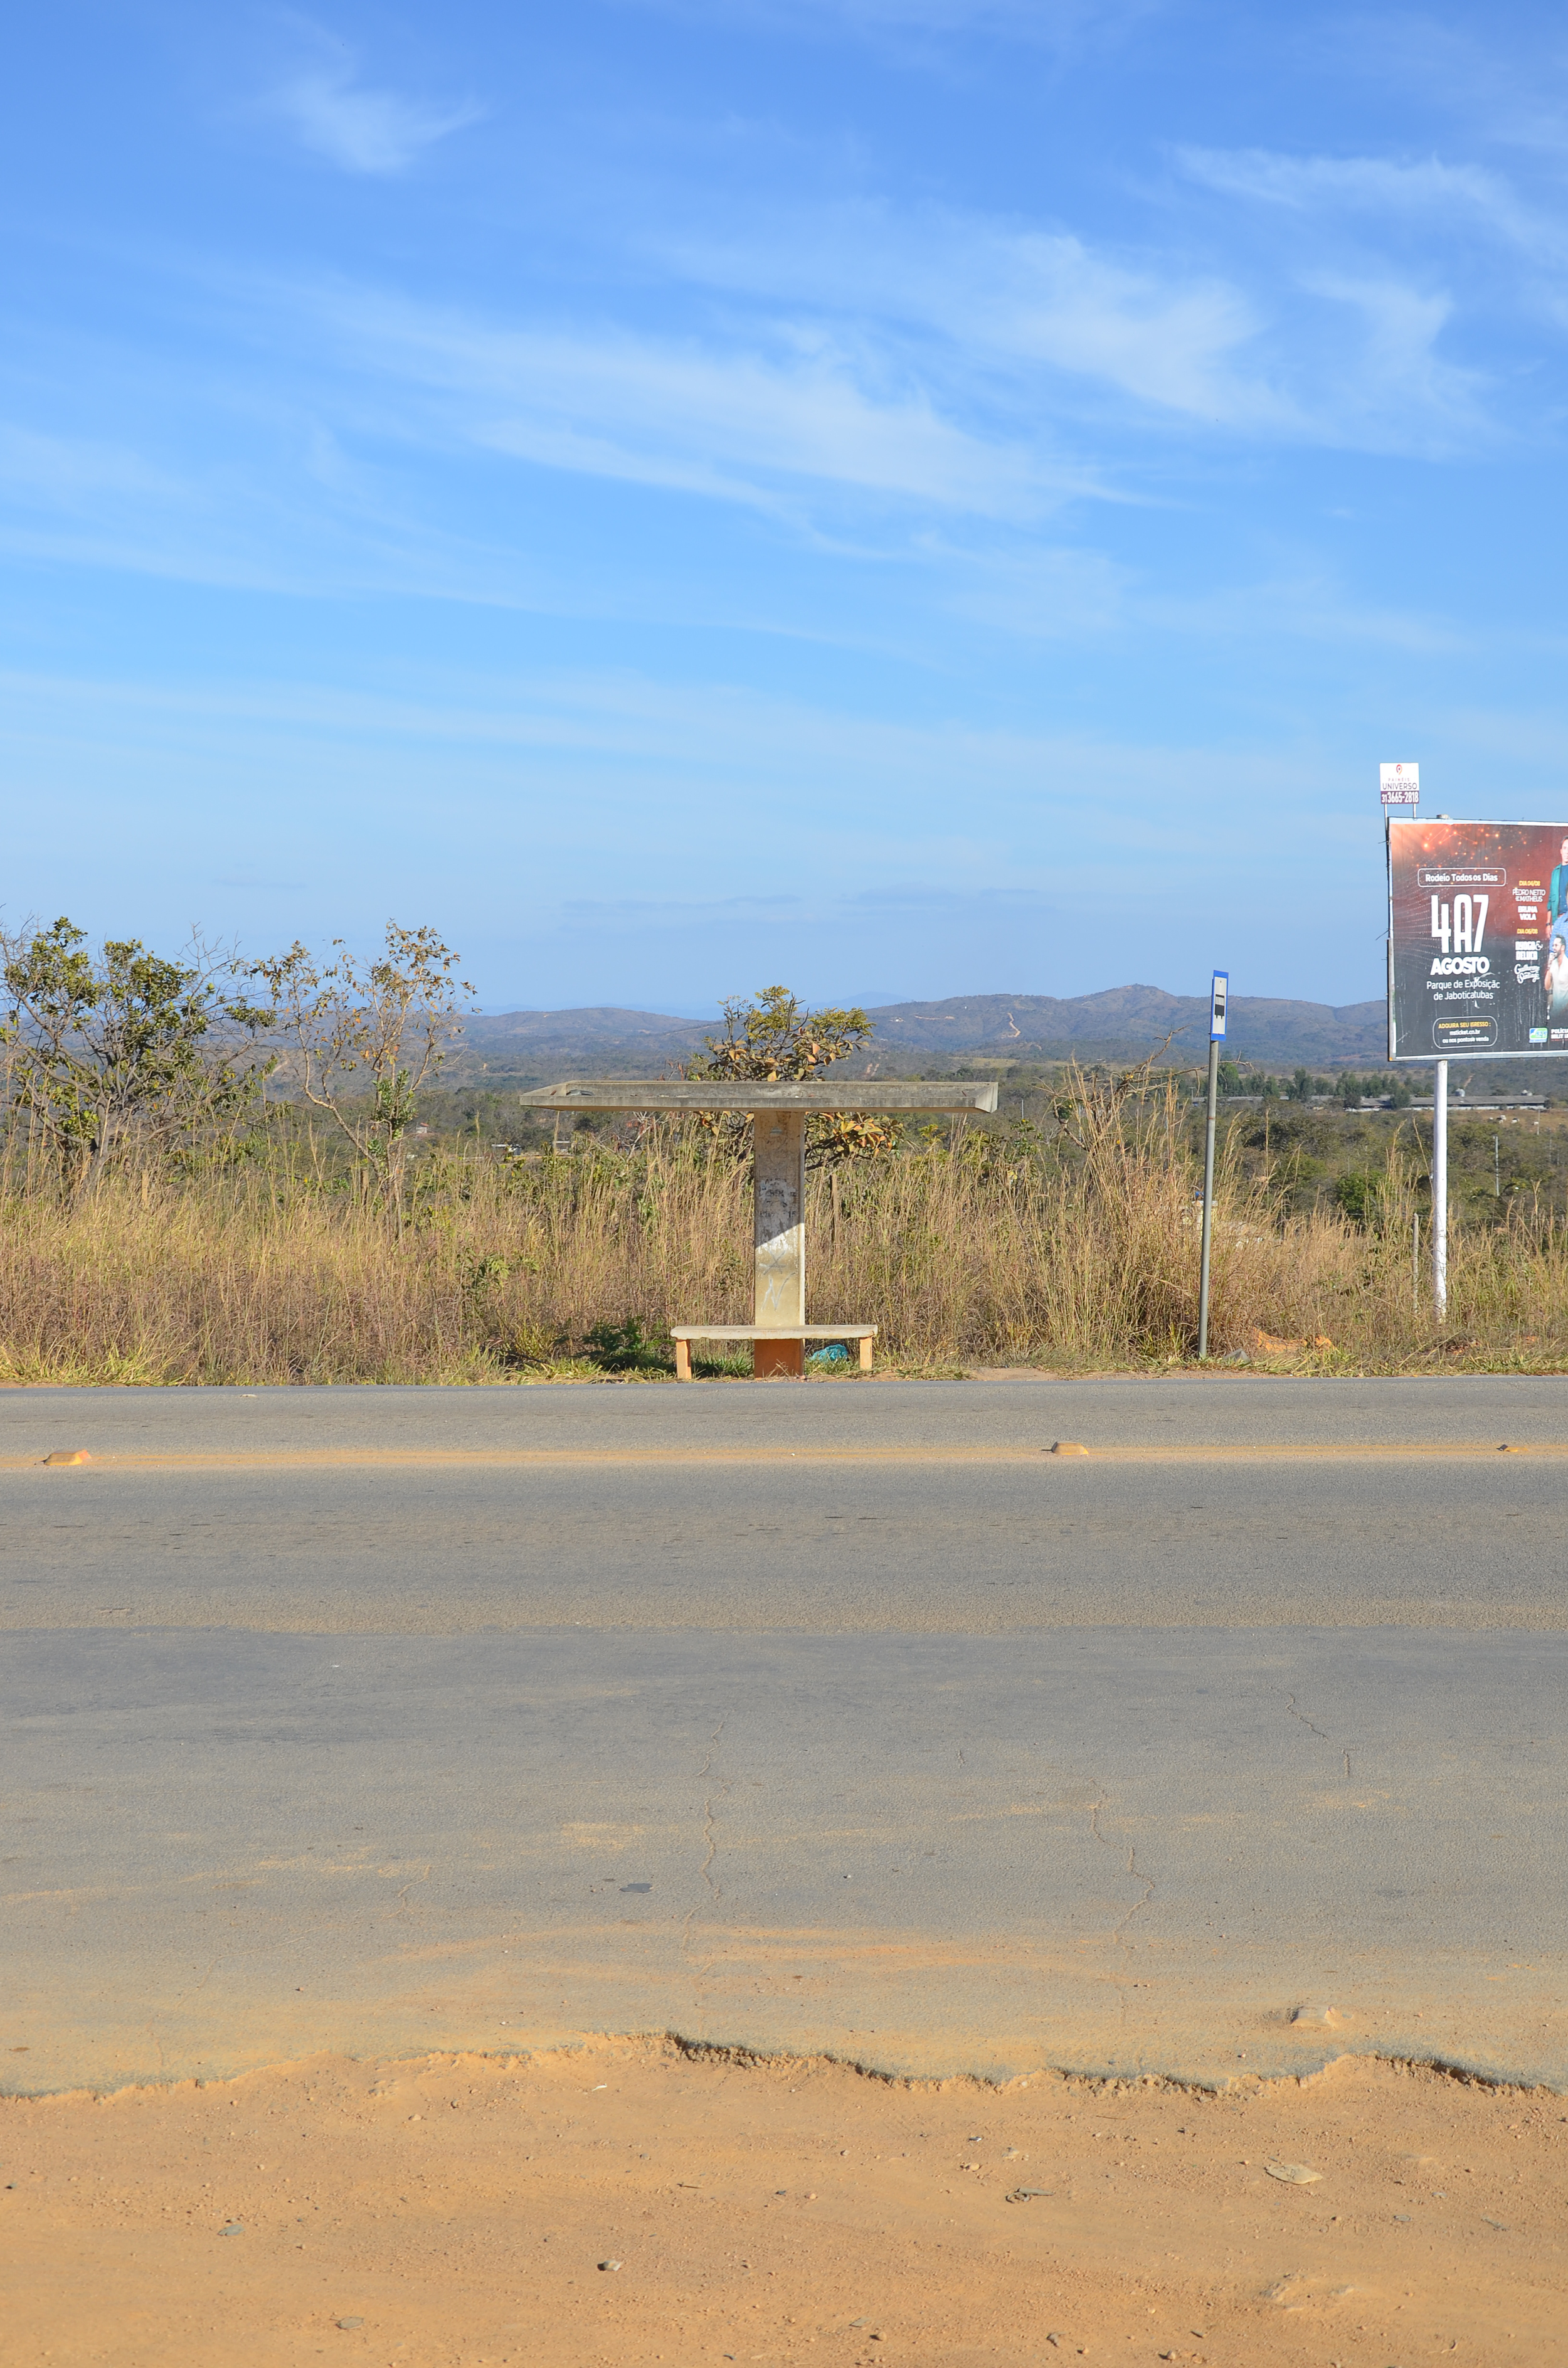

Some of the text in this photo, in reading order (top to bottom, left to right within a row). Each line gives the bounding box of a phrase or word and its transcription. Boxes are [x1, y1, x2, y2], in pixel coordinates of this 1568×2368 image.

[1382, 782, 1417, 790] UNIVERSO
[1387, 791, 1419, 803] 3665-2818
[1425, 873, 1450, 882] Rodeio
[1451, 873, 1472, 882] Todos
[1483, 873, 1498, 881] Dias
[1430, 956, 1490, 975] AGOSTO
[1426, 980, 1452, 990] Parque
[1453, 980, 1463, 989] de
[1433, 990, 1494, 1001] de Jaboticatubas
